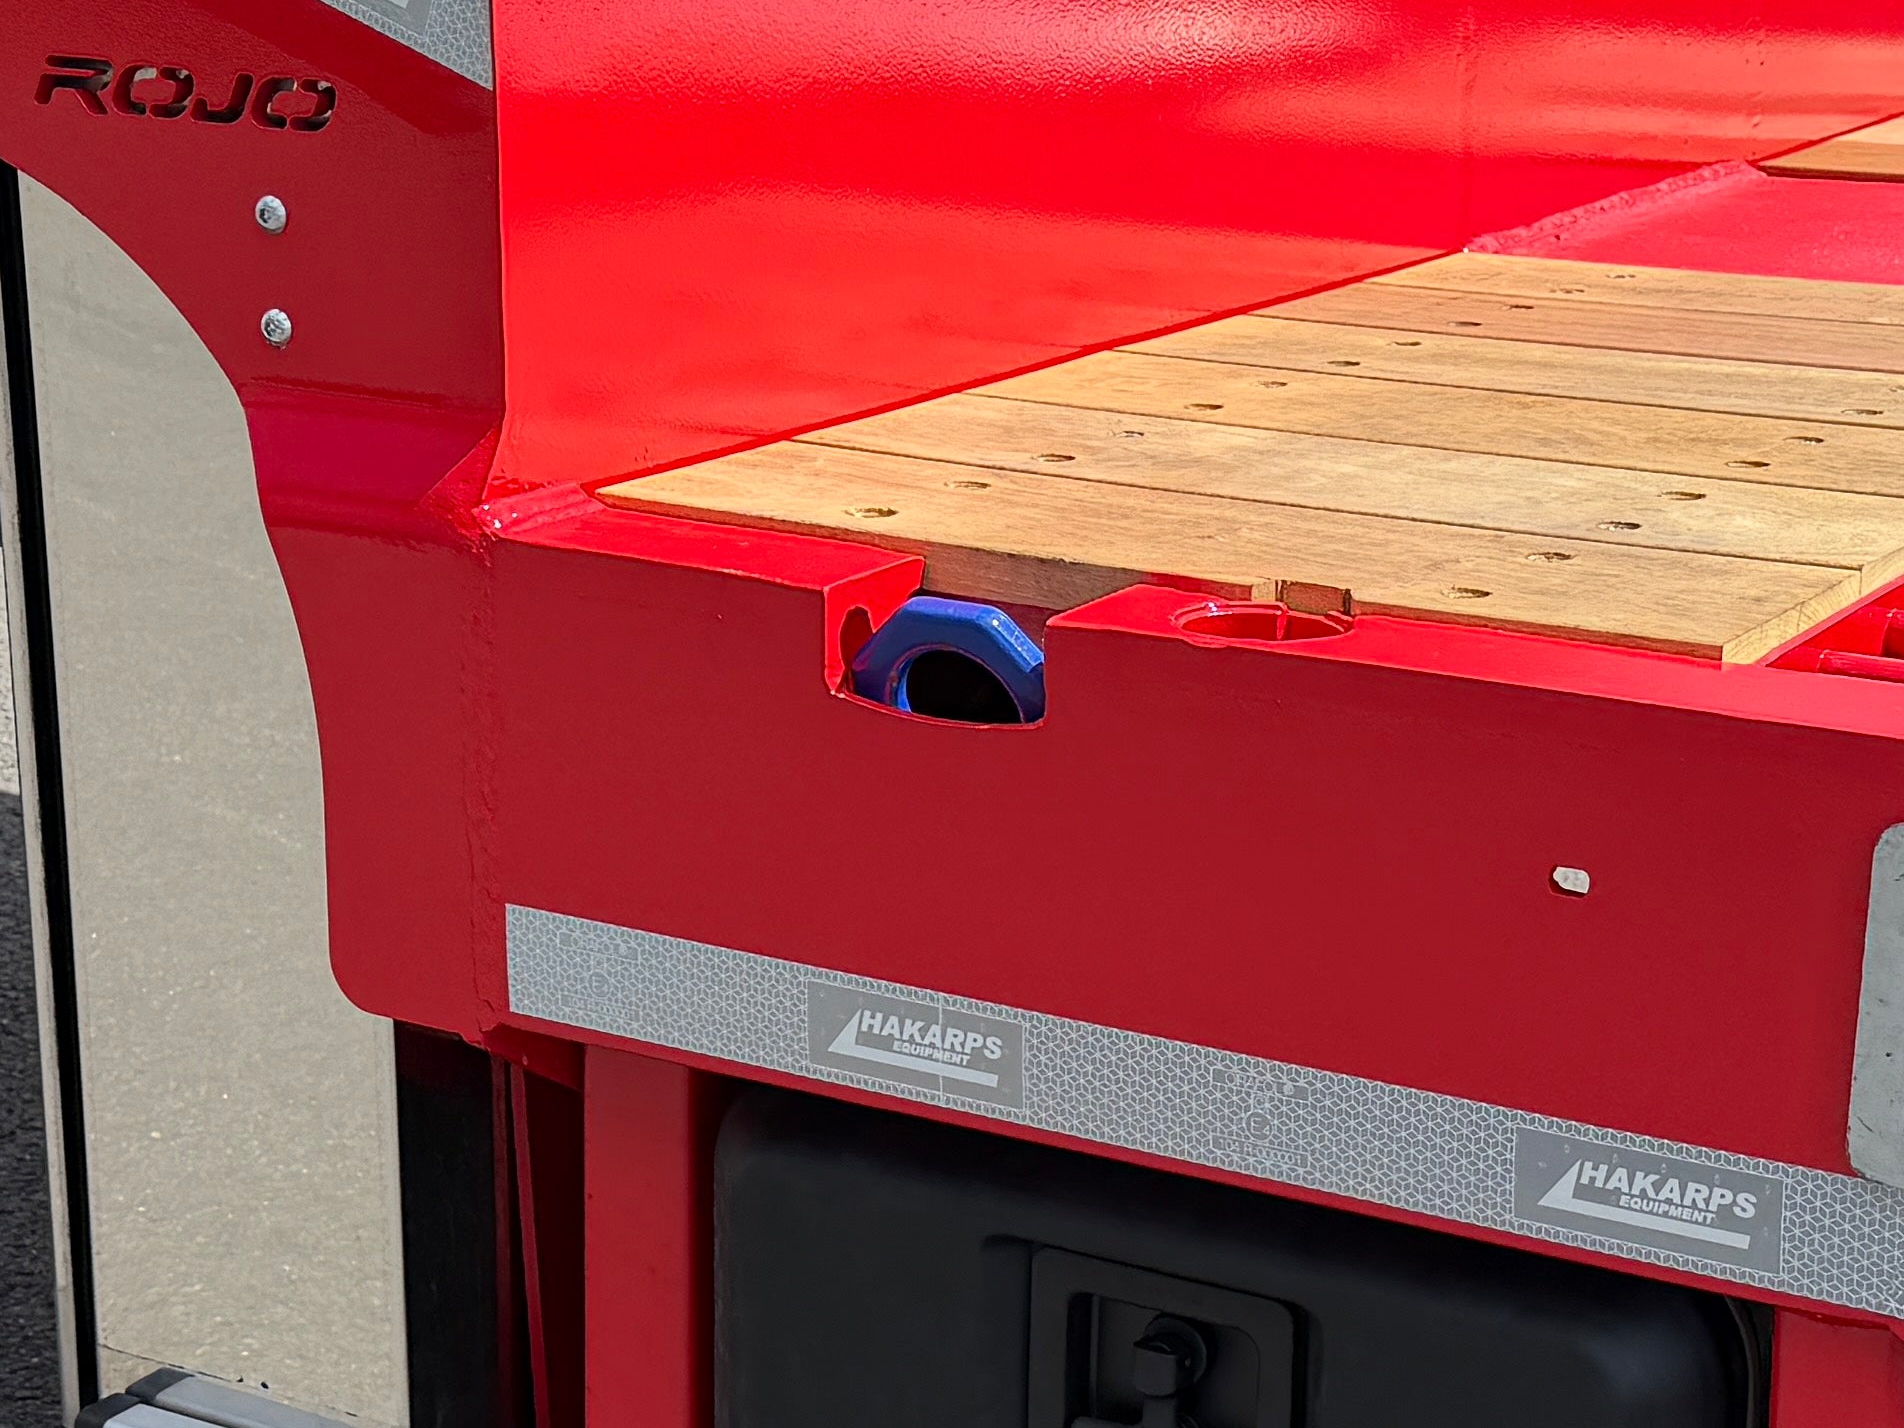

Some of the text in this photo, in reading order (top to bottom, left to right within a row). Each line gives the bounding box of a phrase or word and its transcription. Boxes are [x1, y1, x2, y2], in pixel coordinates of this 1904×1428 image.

[34, 54, 337, 133] ROJO
[860, 1009, 1003, 1060] HAKARPS
[892, 1040, 971, 1066] EQUIPMENT
[1579, 1161, 1758, 1218] HAKARPS
[1619, 1195, 1716, 1225] EQUIPMENT
